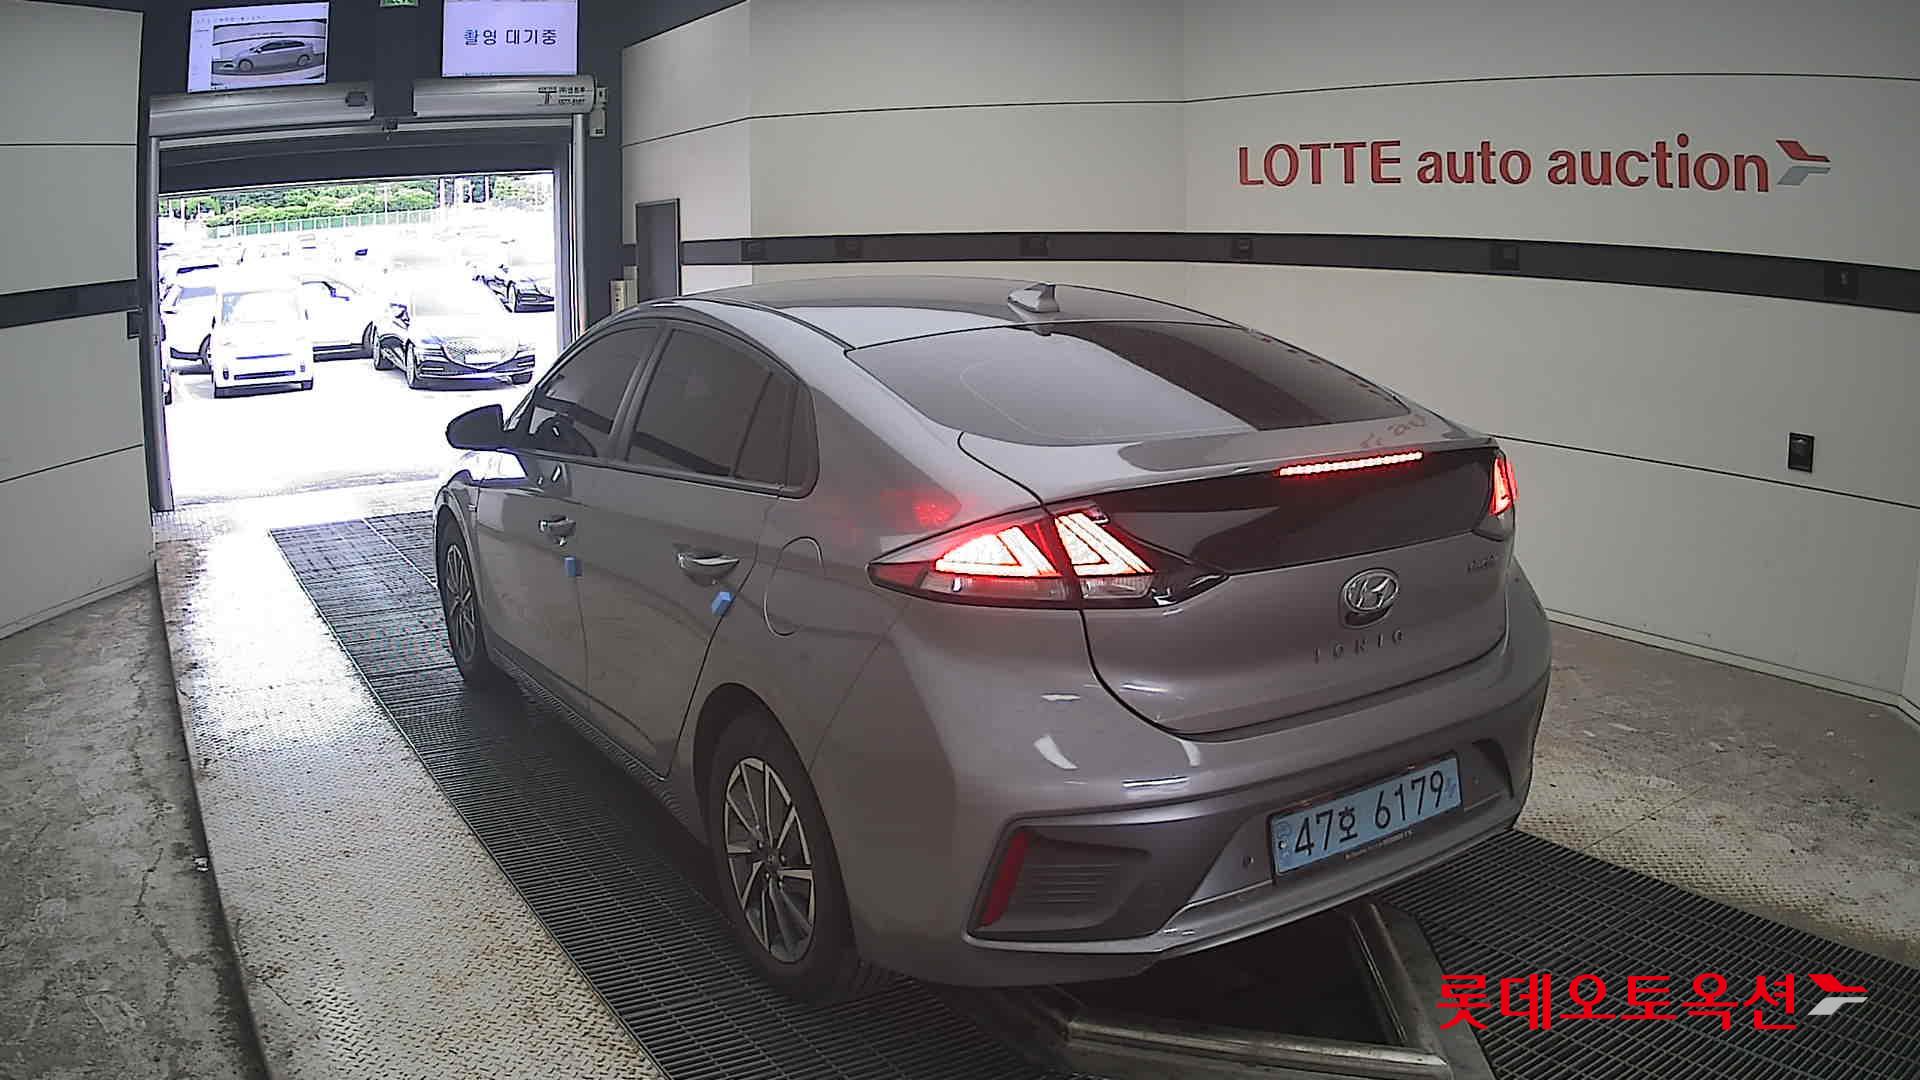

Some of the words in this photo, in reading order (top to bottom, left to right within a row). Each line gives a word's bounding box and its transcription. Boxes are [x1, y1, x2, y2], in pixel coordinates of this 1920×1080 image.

[464, 29, 497, 46] 촬영
[505, 29, 558, 46] 대기중
[1238, 140, 1401, 187] LOTTE
[1416, 141, 1532, 186] auto
[1547, 133, 1770, 193] auction
[1294, 806, 1358, 856] 47호
[1375, 770, 1445, 829] 6179
